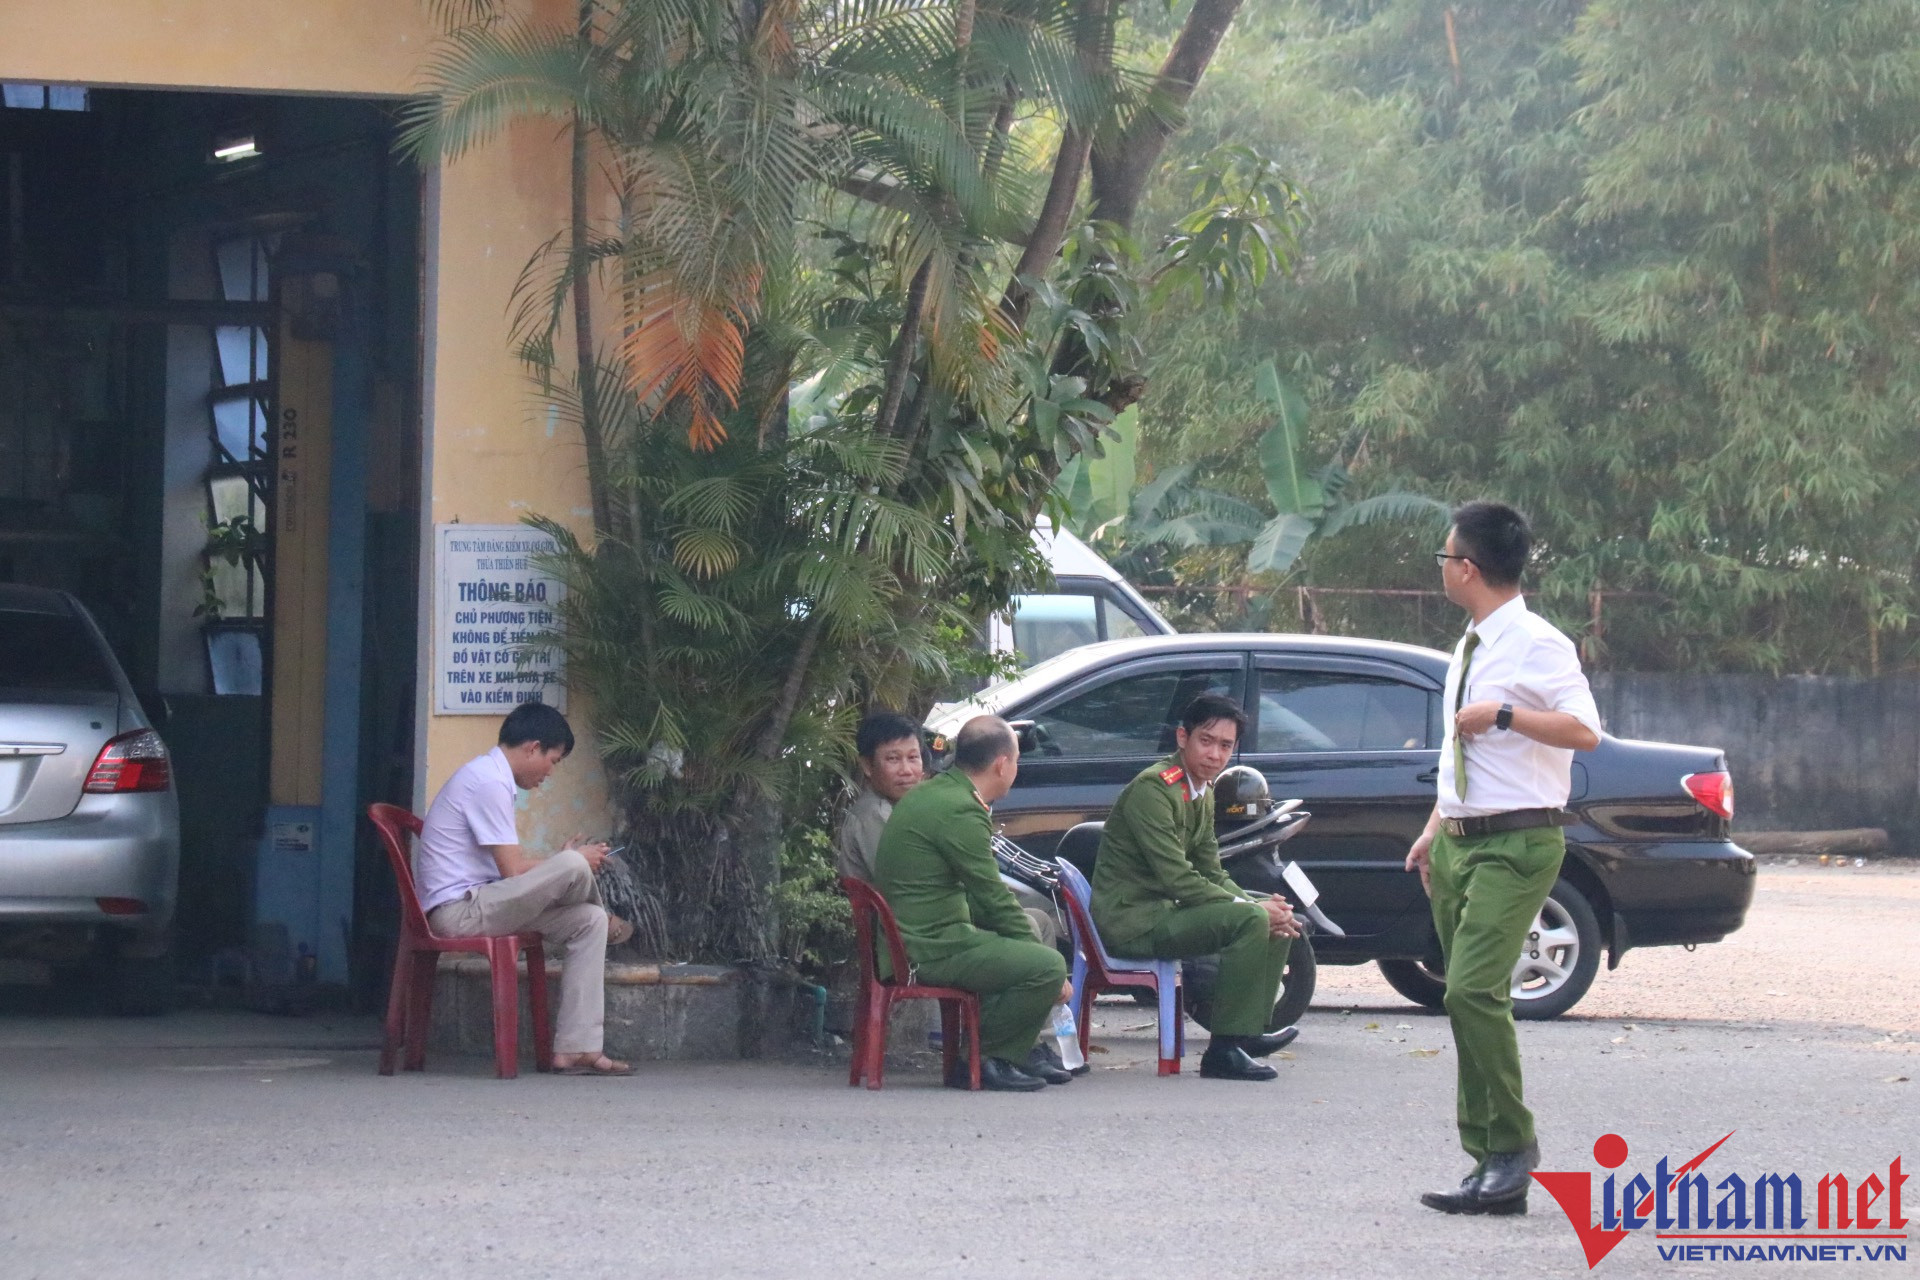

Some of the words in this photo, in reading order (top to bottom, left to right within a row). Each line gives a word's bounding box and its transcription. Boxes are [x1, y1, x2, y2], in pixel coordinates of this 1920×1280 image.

[283, 407, 297, 440] 230
[282, 445, 297, 459] R
[450, 540, 472, 553] TRUNG
[472, 537, 486, 553] TÂM
[458, 578, 510, 602] THÔNG
[515, 578, 546, 602] BÁO
[455, 607, 477, 624] CHỦ
[480, 610, 525, 624] PHƯƠNG
[452, 629, 490, 644] KHÔNG
[493, 626, 508, 644] ĐỂ
[471, 649, 491, 666] VẬT
[494, 648, 509, 664] CÓ
[447, 669, 476, 684] TRÊN
[478, 671, 492, 684] XE
[495, 671, 514, 684] KHI
[460, 689, 482, 704] VÀO
[485, 687, 513, 704] KIỂM
